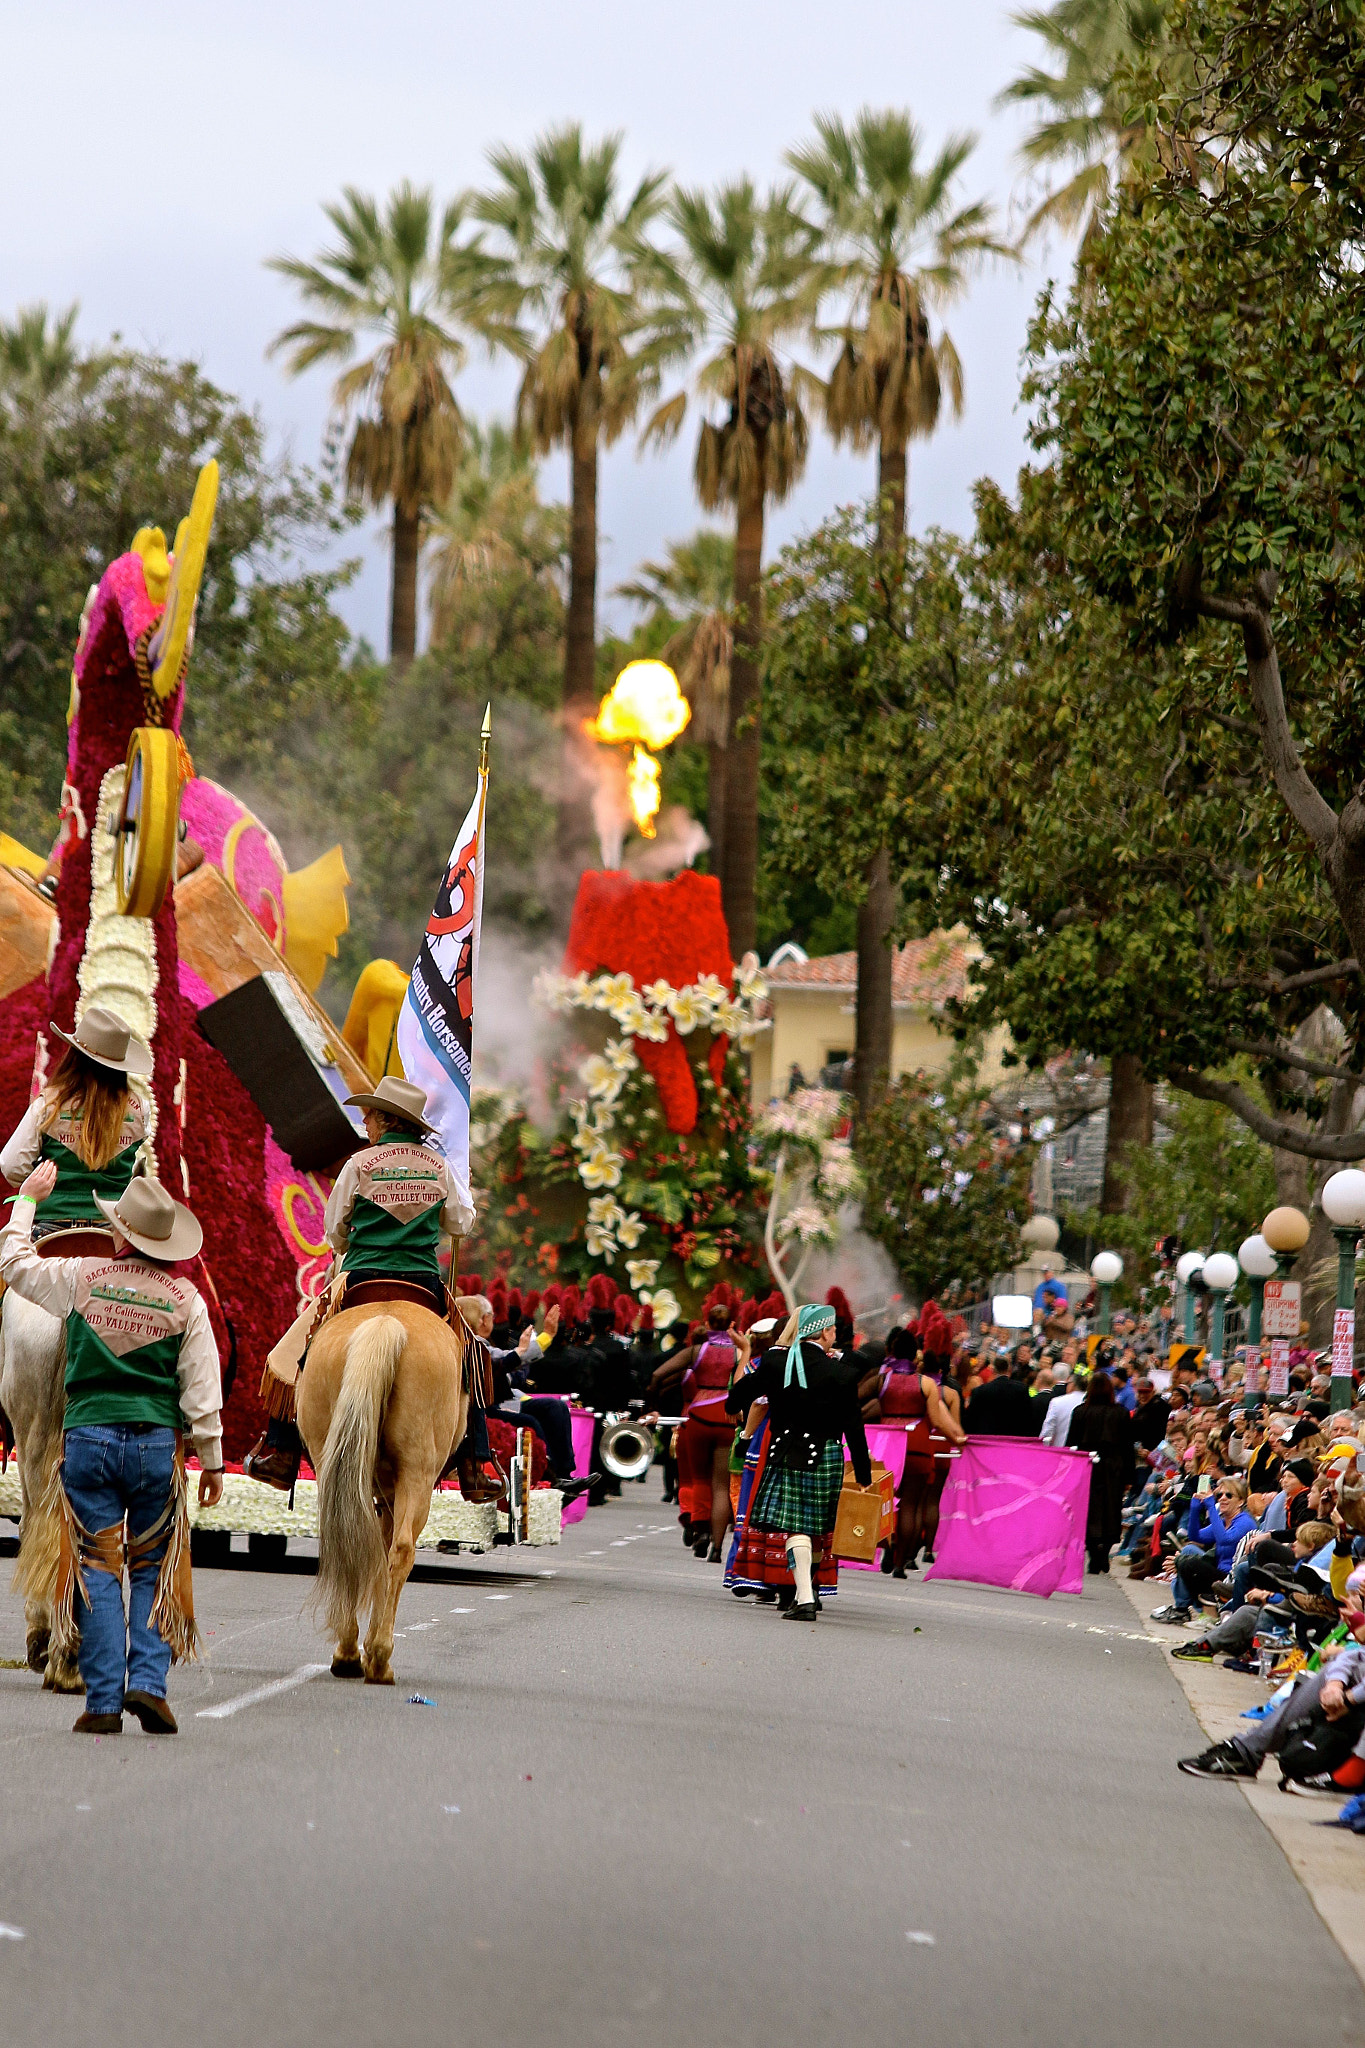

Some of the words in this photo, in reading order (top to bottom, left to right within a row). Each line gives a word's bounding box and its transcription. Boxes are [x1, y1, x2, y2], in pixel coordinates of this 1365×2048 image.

[411, 954, 434, 1015] Country
[362, 1147, 410, 1171] BACKCOUNTRY
[411, 1149, 443, 1170] HORSEMEN
[372, 1194, 387, 1203] MID
[390, 1193, 420, 1202] VALLEY
[422, 1193, 440, 1202] UNIT
[386, 1183, 393, 1191] of
[395, 1182, 426, 1191] California
[85, 1264, 147, 1283] BACKCOUNTRY
[147, 1270, 186, 1302] HORSEMEN
[103, 1304, 113, 1313] of
[115, 1305, 154, 1322] California
[85, 1314, 102, 1325] MID
[106, 1316, 143, 1333] VALLEY
[146, 1325, 169, 1339] UNIT
